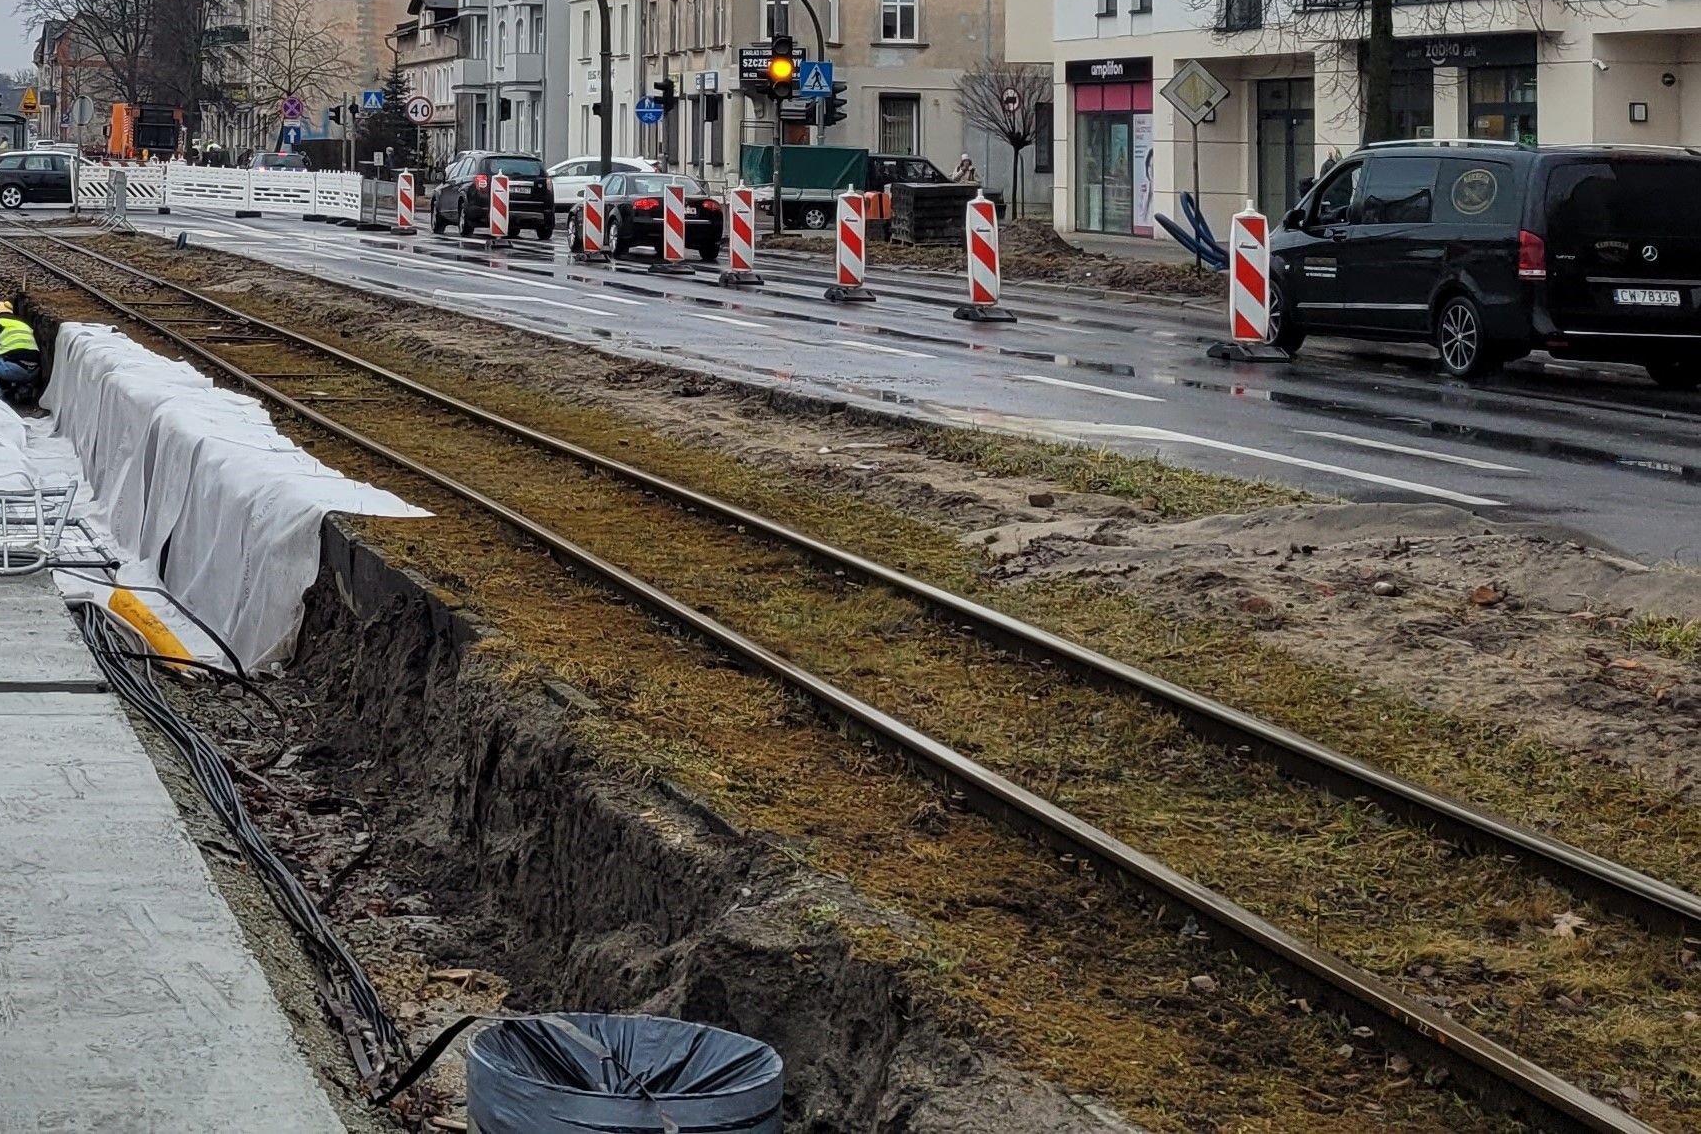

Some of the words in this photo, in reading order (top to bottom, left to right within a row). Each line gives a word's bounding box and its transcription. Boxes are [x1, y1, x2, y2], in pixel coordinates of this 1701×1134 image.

[1091, 60, 1124, 79] amplifon
[409, 104, 430, 118] 40
[1620, 290, 1637, 302] CW
[1641, 290, 1678, 303] 7833G
